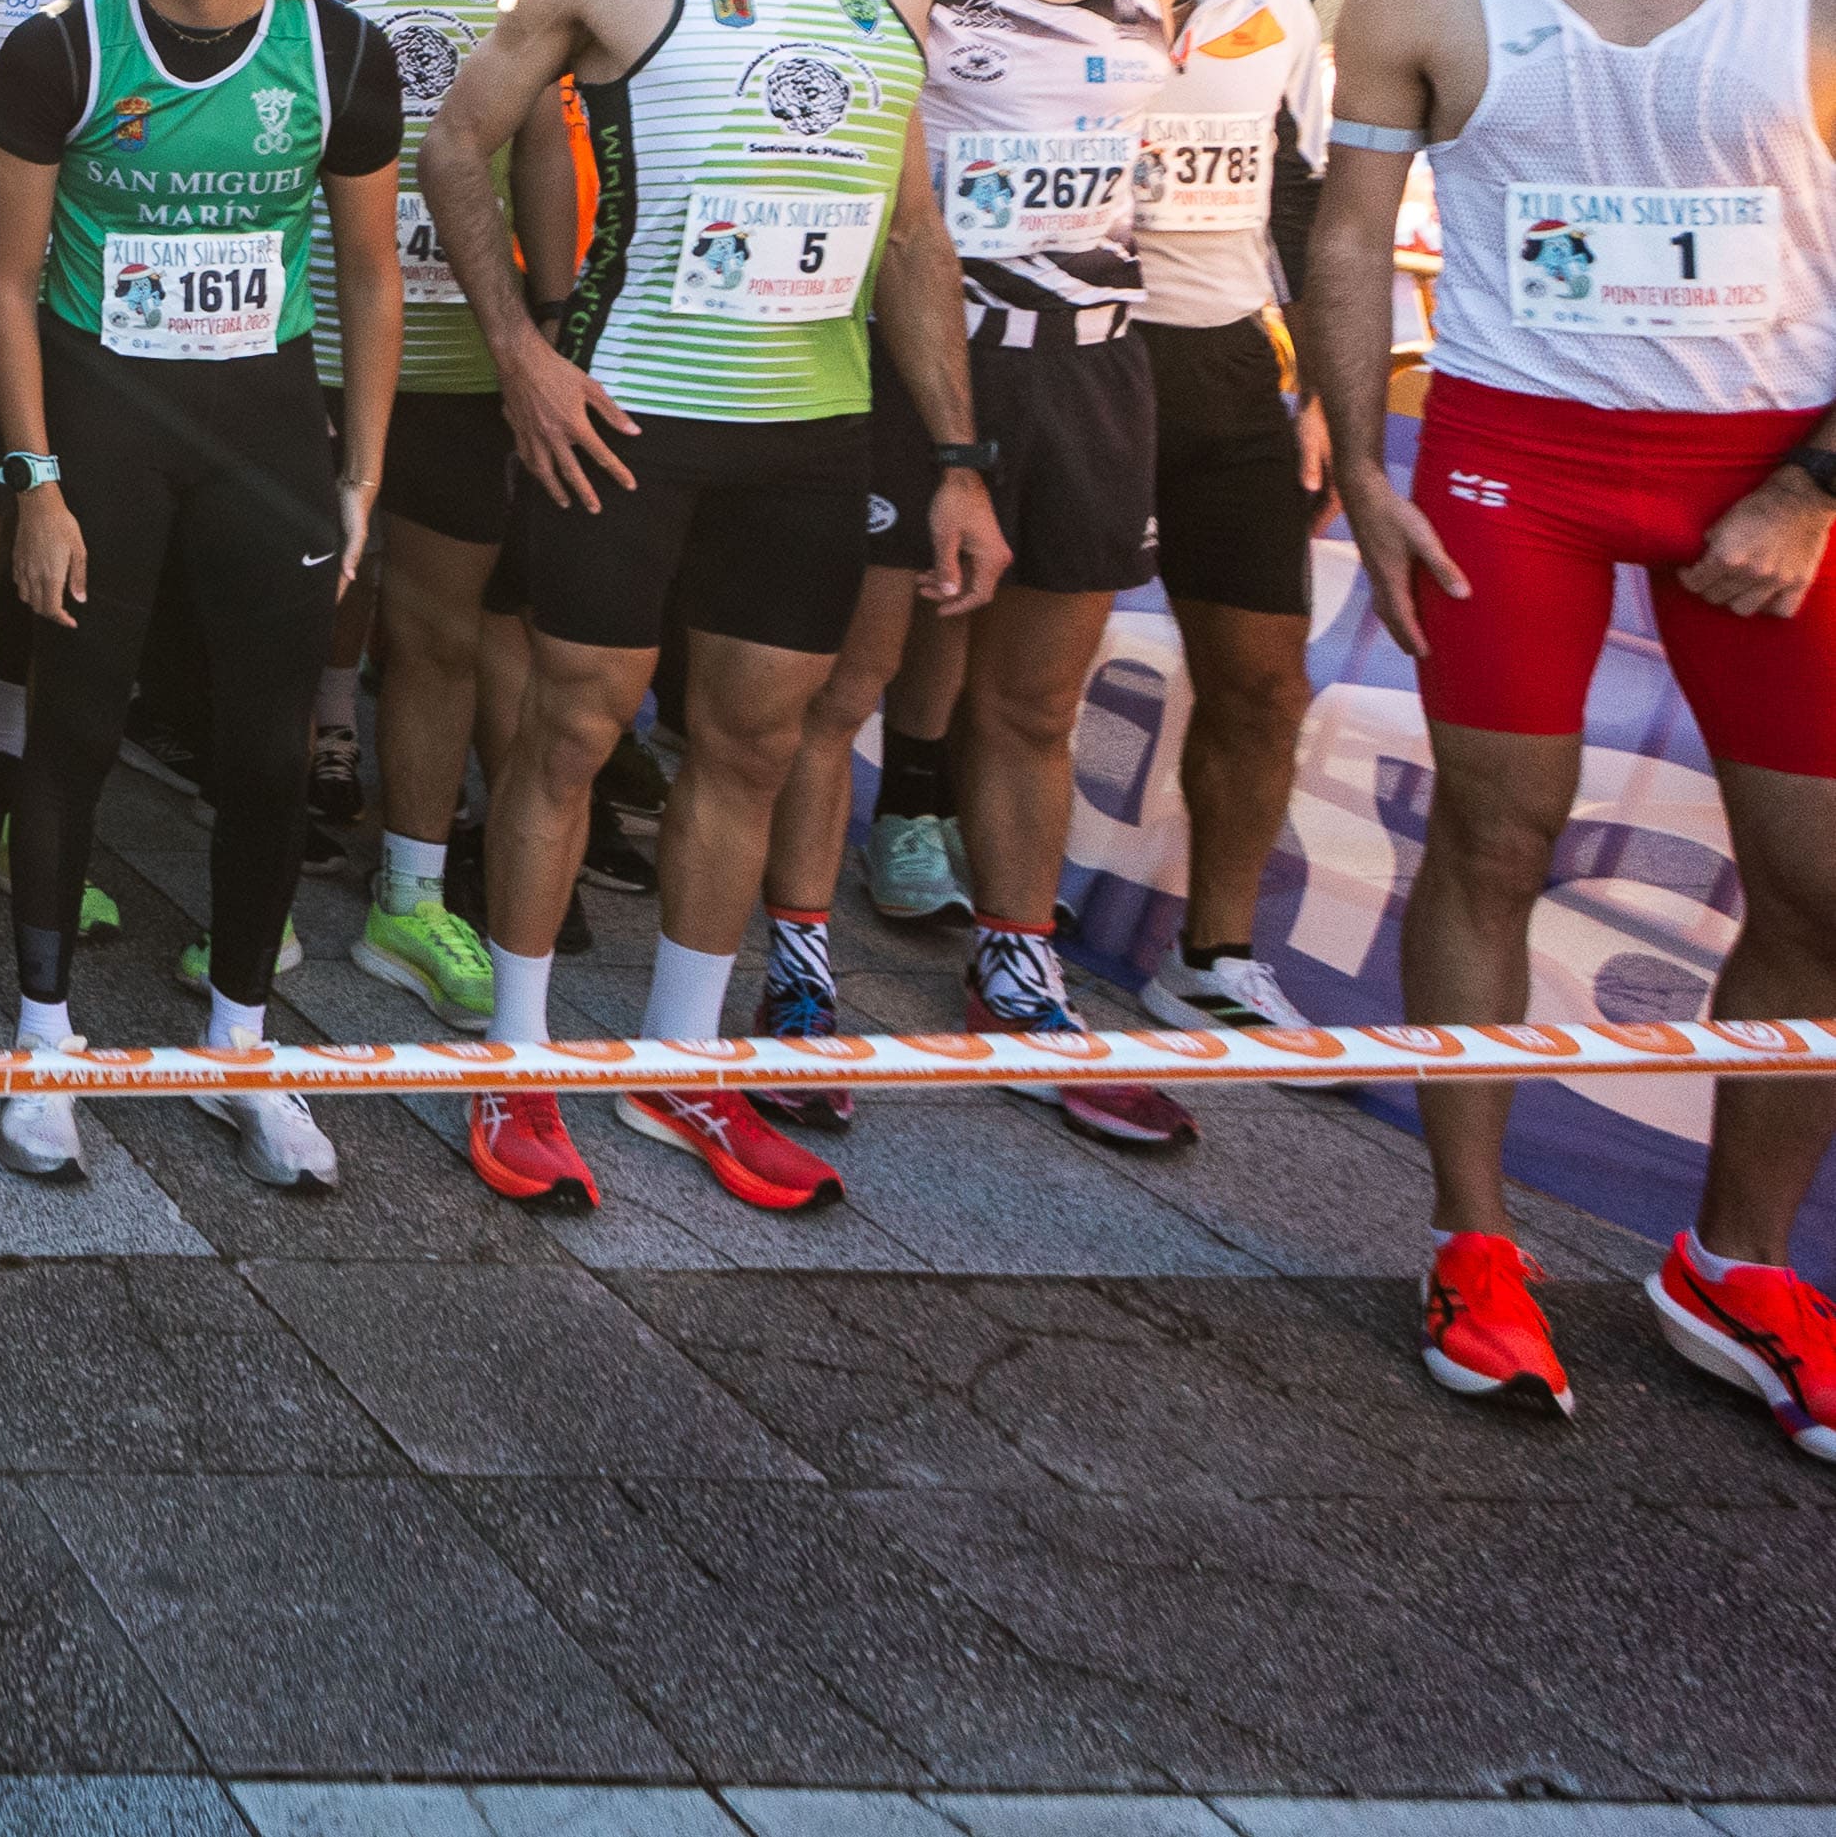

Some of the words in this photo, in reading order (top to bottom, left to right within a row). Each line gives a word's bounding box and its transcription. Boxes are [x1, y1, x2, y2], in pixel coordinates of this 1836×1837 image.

[998, 139, 1040, 162] SAN
[87, 161, 159, 194] SAN
[167, 166, 305, 195] MIGUEL
[1024, 167, 1124, 208] 2672
[138, 199, 262, 227] MARÍN
[743, 201, 782, 225] SAN
[786, 201, 873, 227] SILVESTRE
[1571, 195, 1624, 224] SAN
[1632, 196, 1764, 226] SILVESTRE
[112, 239, 145, 264] XLII
[151, 241, 188, 266] SAN
[193, 235, 275, 266] SILVESTRE
[800, 233, 827, 273] 5
[1671, 231, 1696, 279] 1
[179, 268, 267, 313] 1614
[1723, 284, 1767, 305] 2025
[167, 315, 243, 335] PONTEVEDRA
